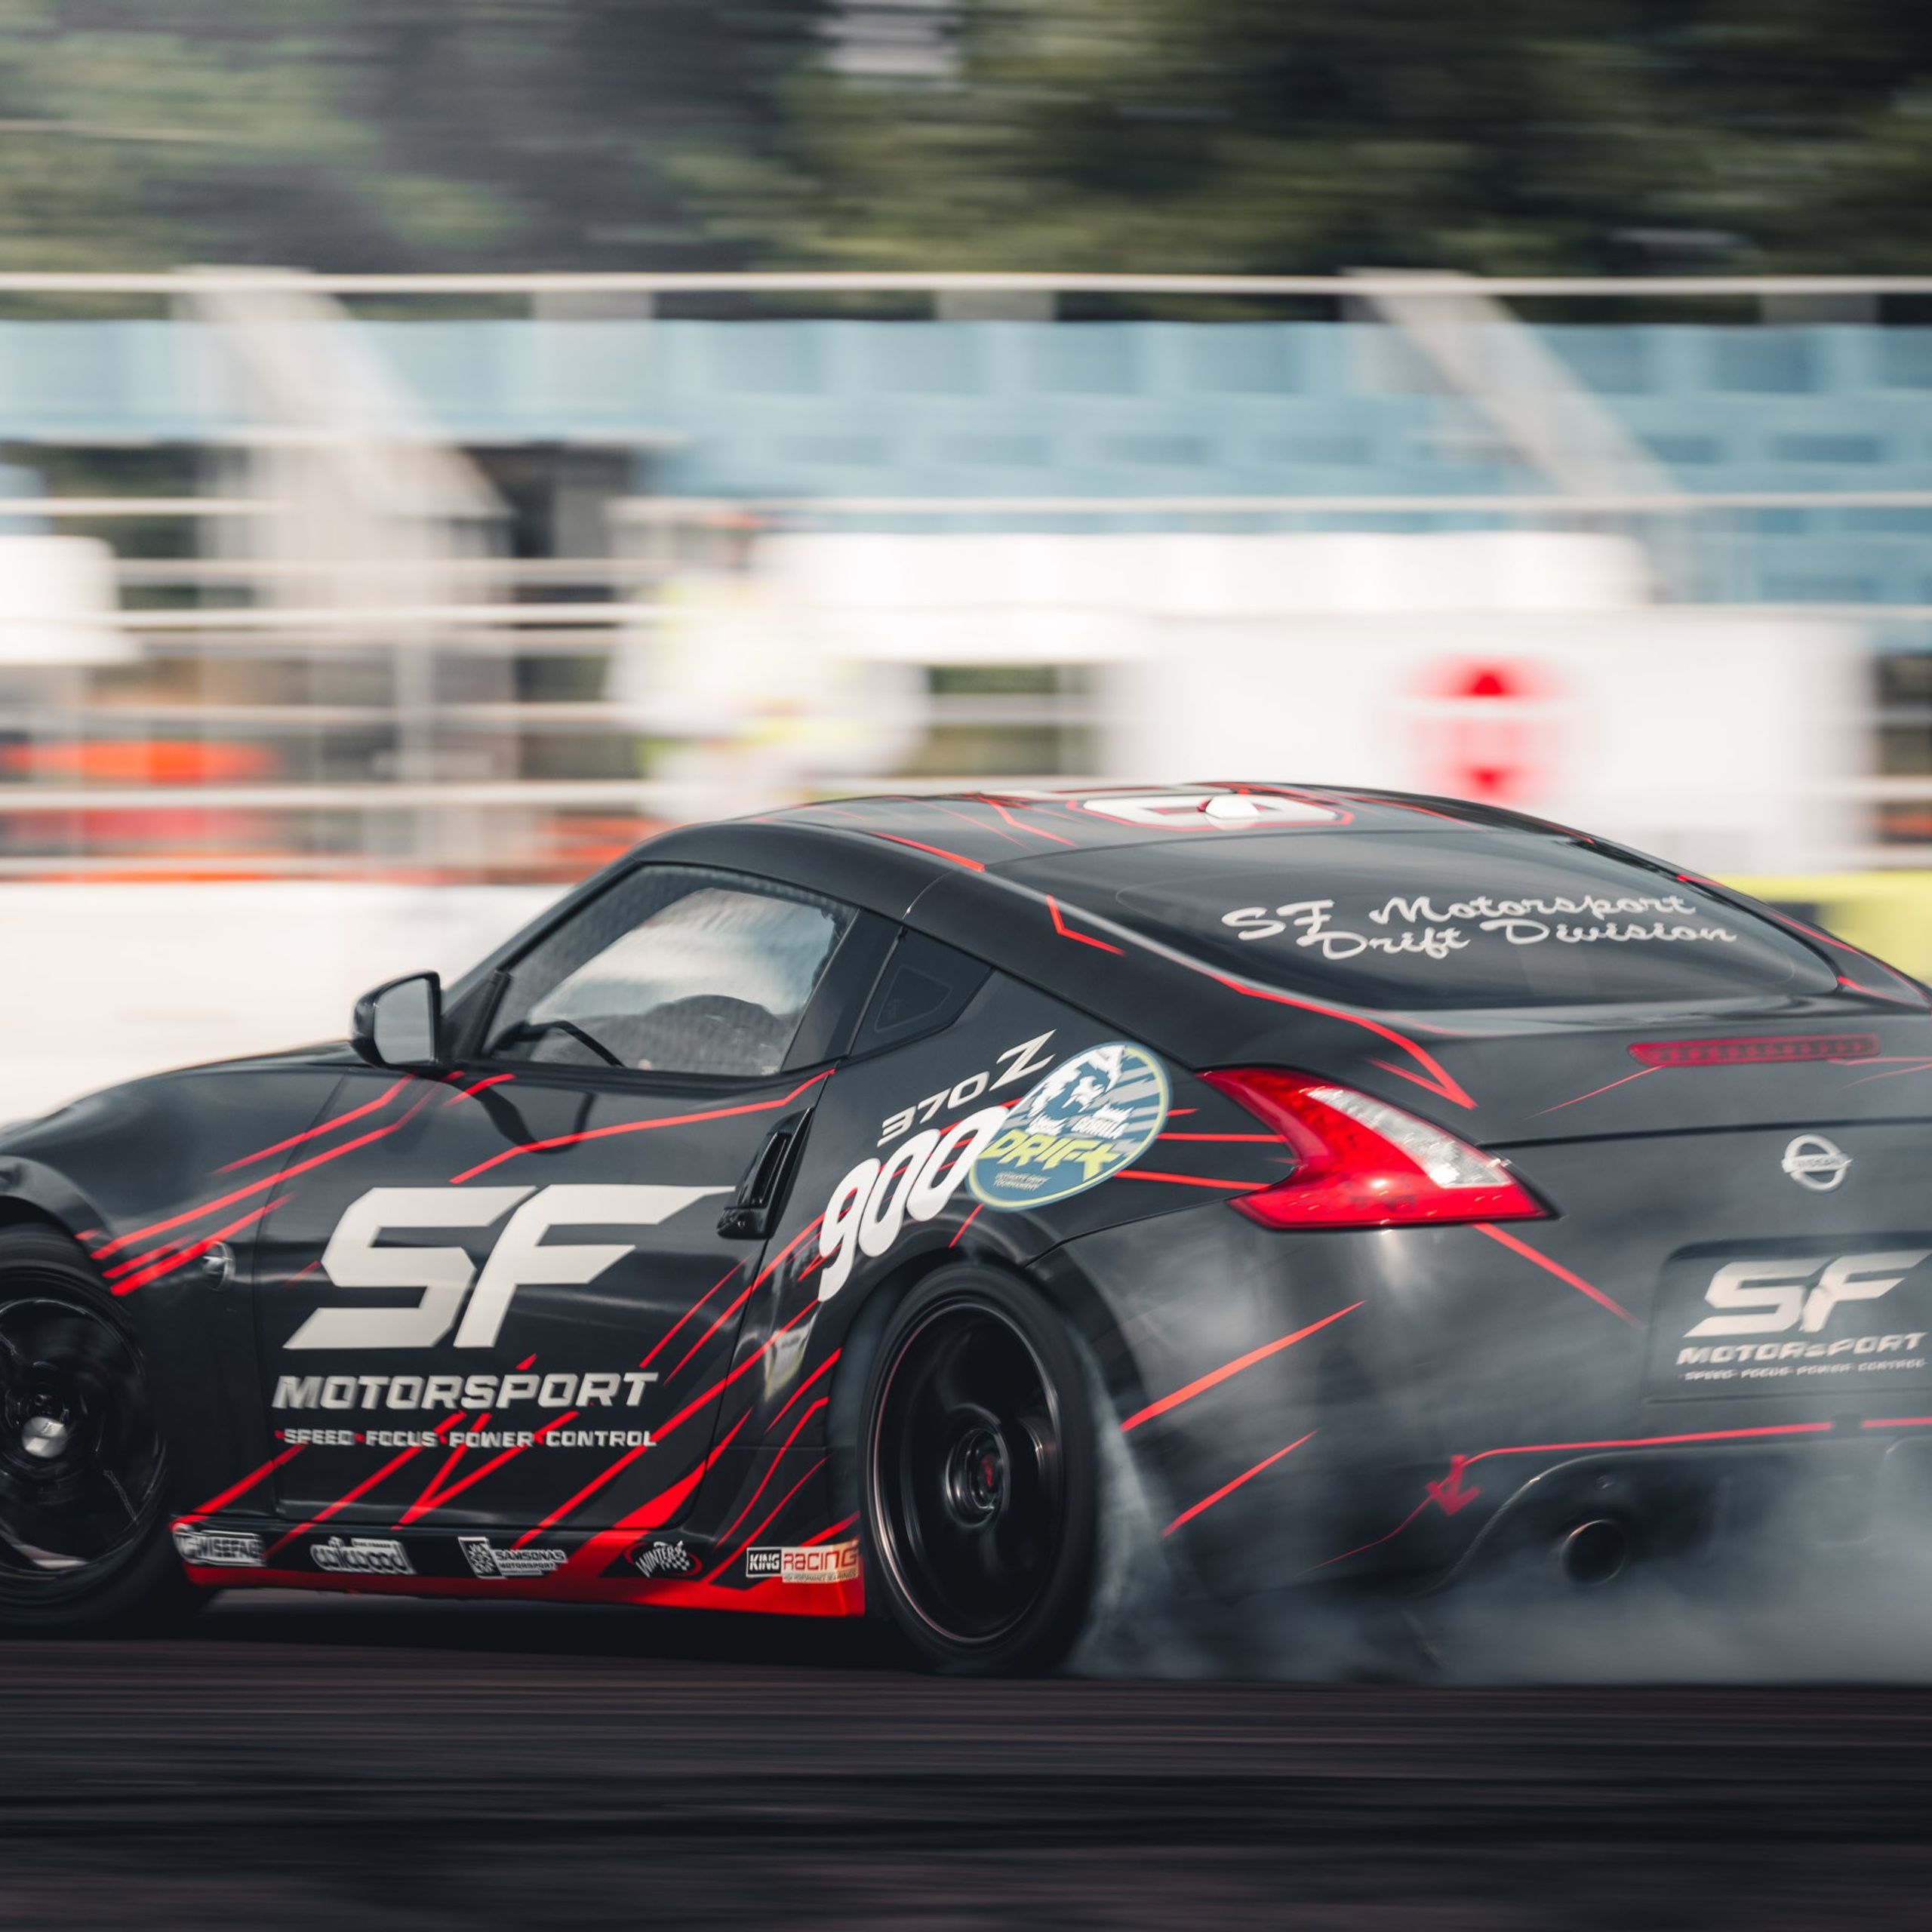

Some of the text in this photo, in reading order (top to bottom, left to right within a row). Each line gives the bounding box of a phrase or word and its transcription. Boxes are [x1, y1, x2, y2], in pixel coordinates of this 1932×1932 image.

[1221, 894, 1697, 941] SF Motorsport
[1294, 918, 1737, 960] Drift Division
[978, 1129, 1122, 1182] DRIFT
[817, 1106, 1010, 1302] 900
[281, 1183, 737, 1349] SF
[1682, 1249, 1932, 1338] SF
[1675, 1332, 1927, 1366] MOTORSPORT
[1796, 1362, 1853, 1376] POWER
[271, 1371, 660, 1411] MOTORSPORT
[284, 1428, 658, 1449] SPEED FOCUS POWER CONTROL
[495, 1549, 566, 1562] SAMSONAS
[499, 1561, 555, 1570] MOTORSPORT
[635, 1544, 683, 1578] WINTERS
[749, 1552, 780, 1571] KING
